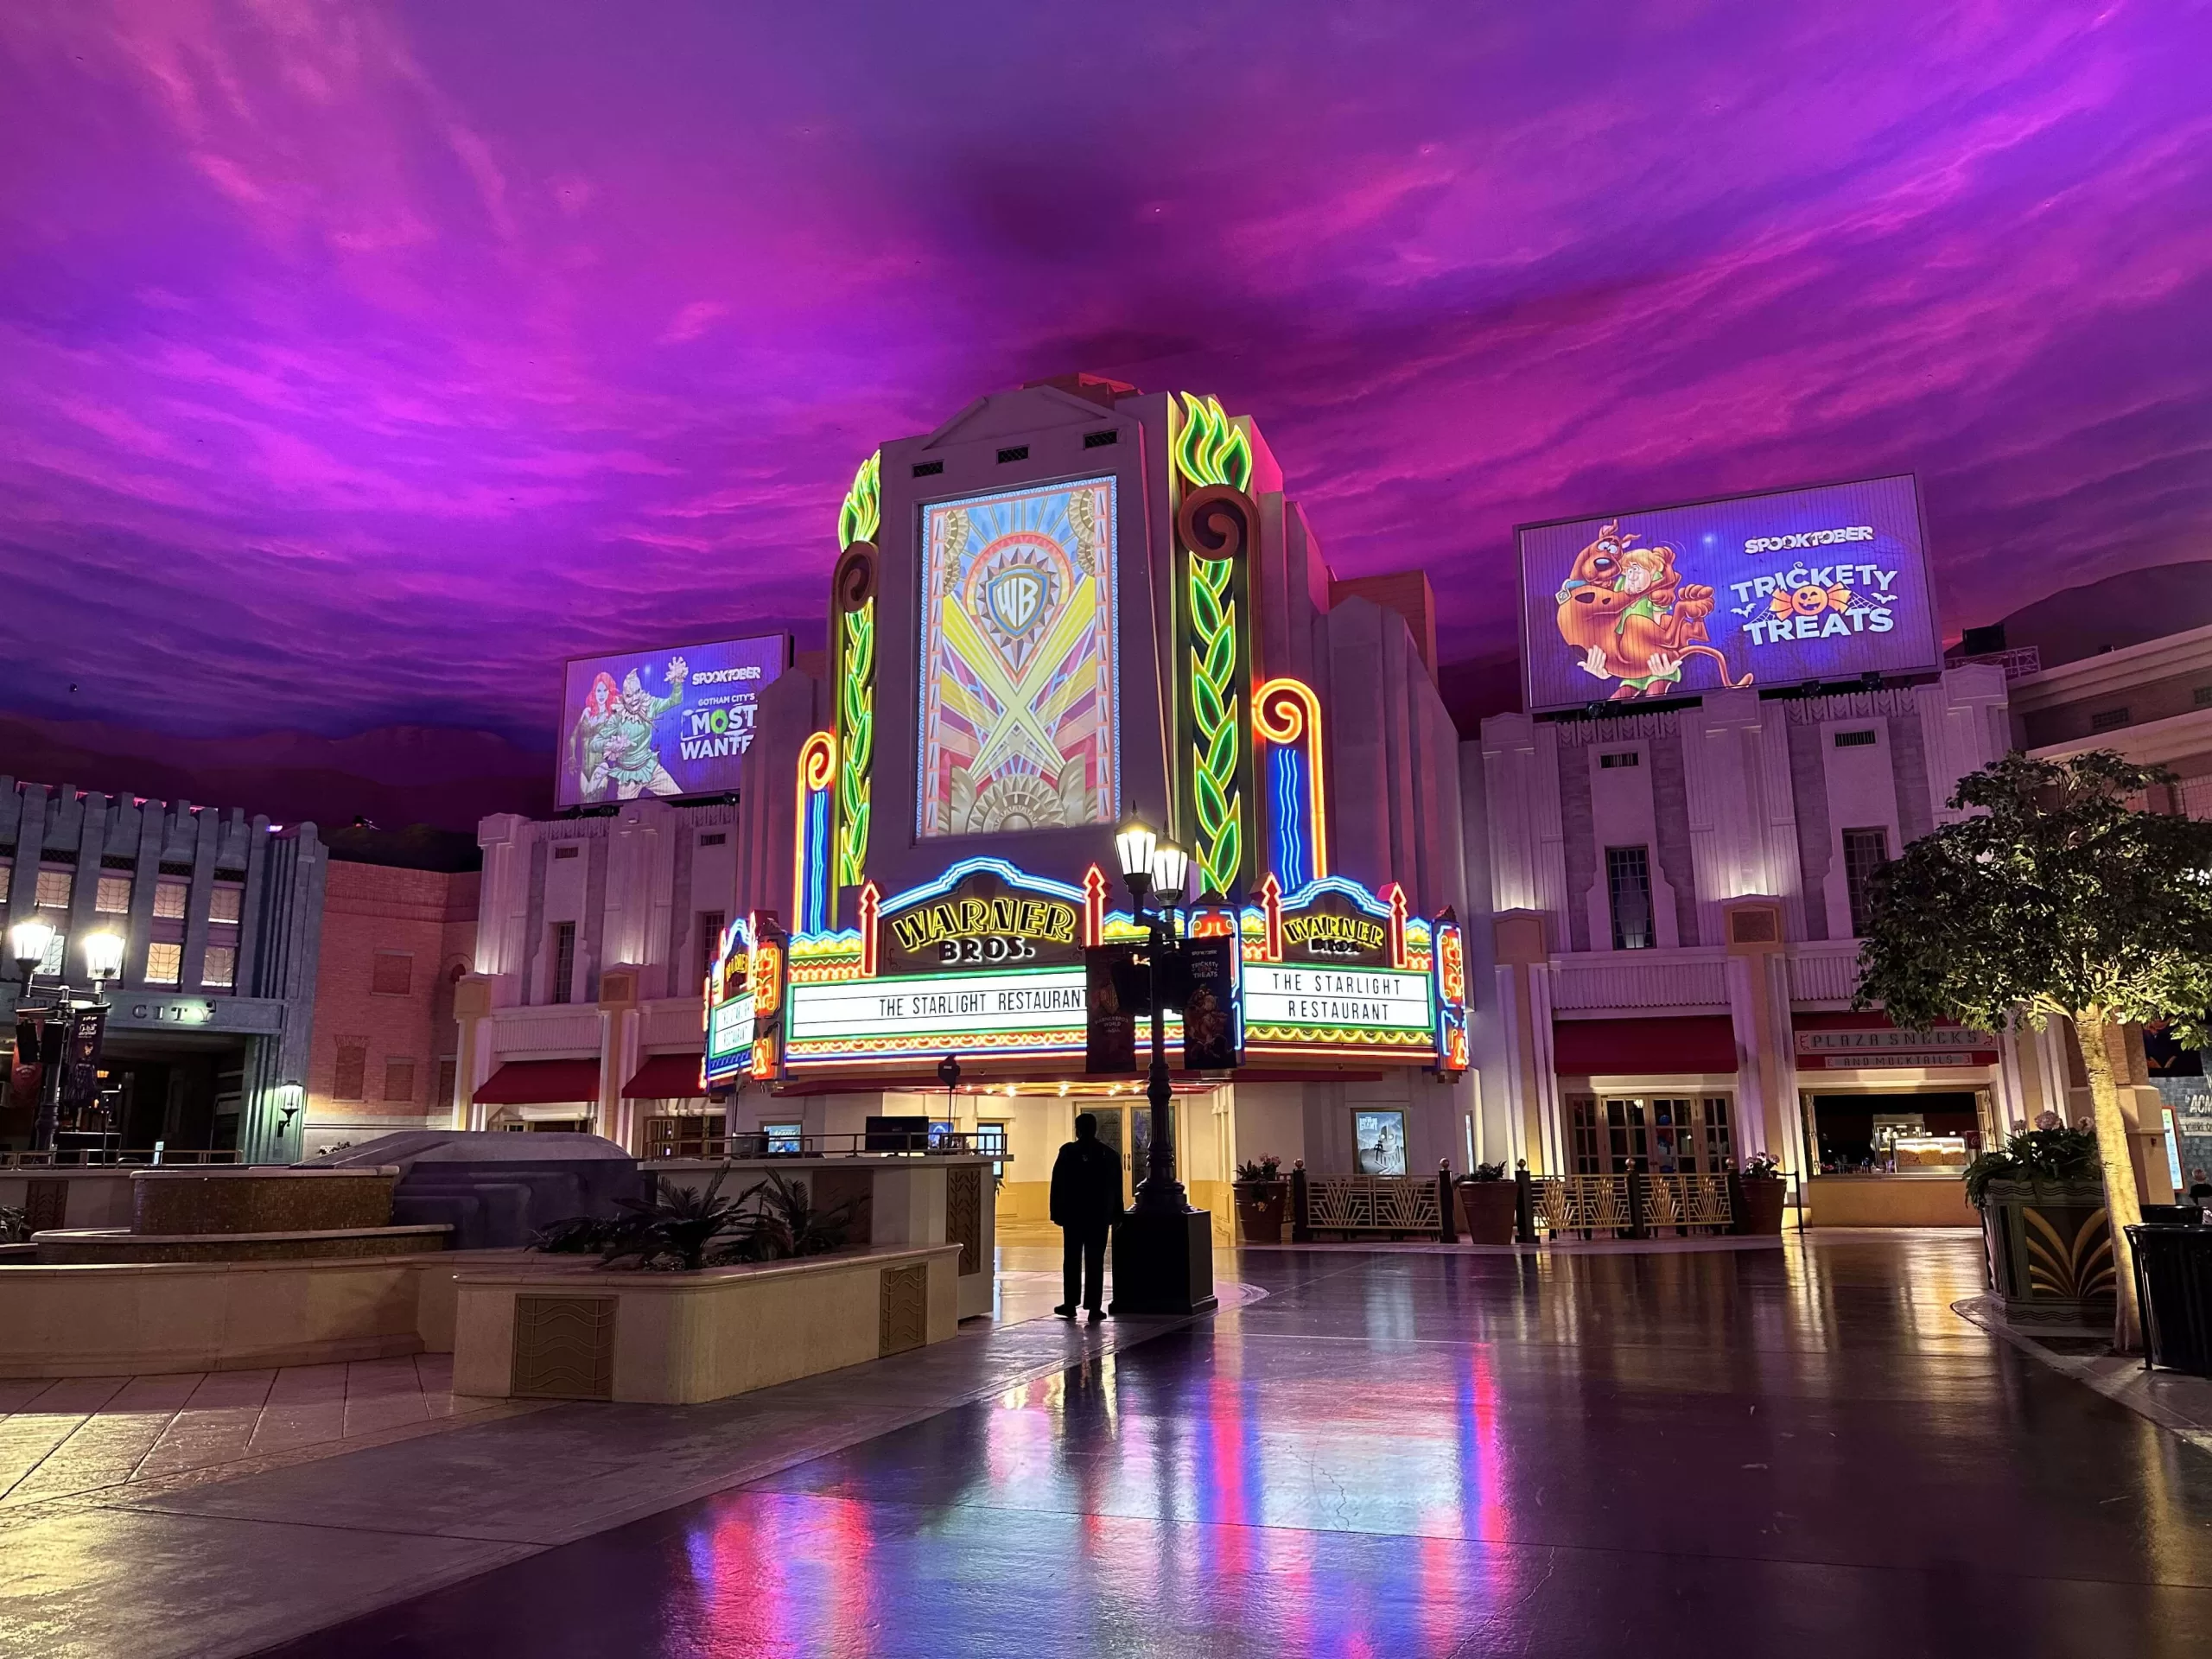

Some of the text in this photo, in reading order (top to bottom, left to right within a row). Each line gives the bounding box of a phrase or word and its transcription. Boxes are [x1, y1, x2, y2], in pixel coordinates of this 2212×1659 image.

[1745, 526, 1874, 554] SPOOKTOBER
[1730, 562, 1897, 603] TRICKETY
[996, 576, 1038, 628] WB
[1743, 607, 1894, 645] TREATS
[692, 667, 760, 685] SPOOKTOBER
[698, 693, 755, 706] GOTHAM CITY'S
[691, 704, 758, 736] MOST
[680, 734, 754, 760] WANTE
[892, 898, 1076, 952] WARNER
[1282, 914, 1384, 948] WARNER
[938, 936, 1036, 963] BROS.
[1273, 973, 1401, 995] THE STARLIGHT
[132, 1004, 213, 1023] CITY
[880, 998, 904, 1016] THE
[912, 994, 987, 1014] STARLIGHT
[1288, 1000, 1389, 1020] RESTAURANT
[1813, 1033, 1879, 1047] PLAZA
[1844, 1055, 1954, 1066] AND MOCKTAILS
